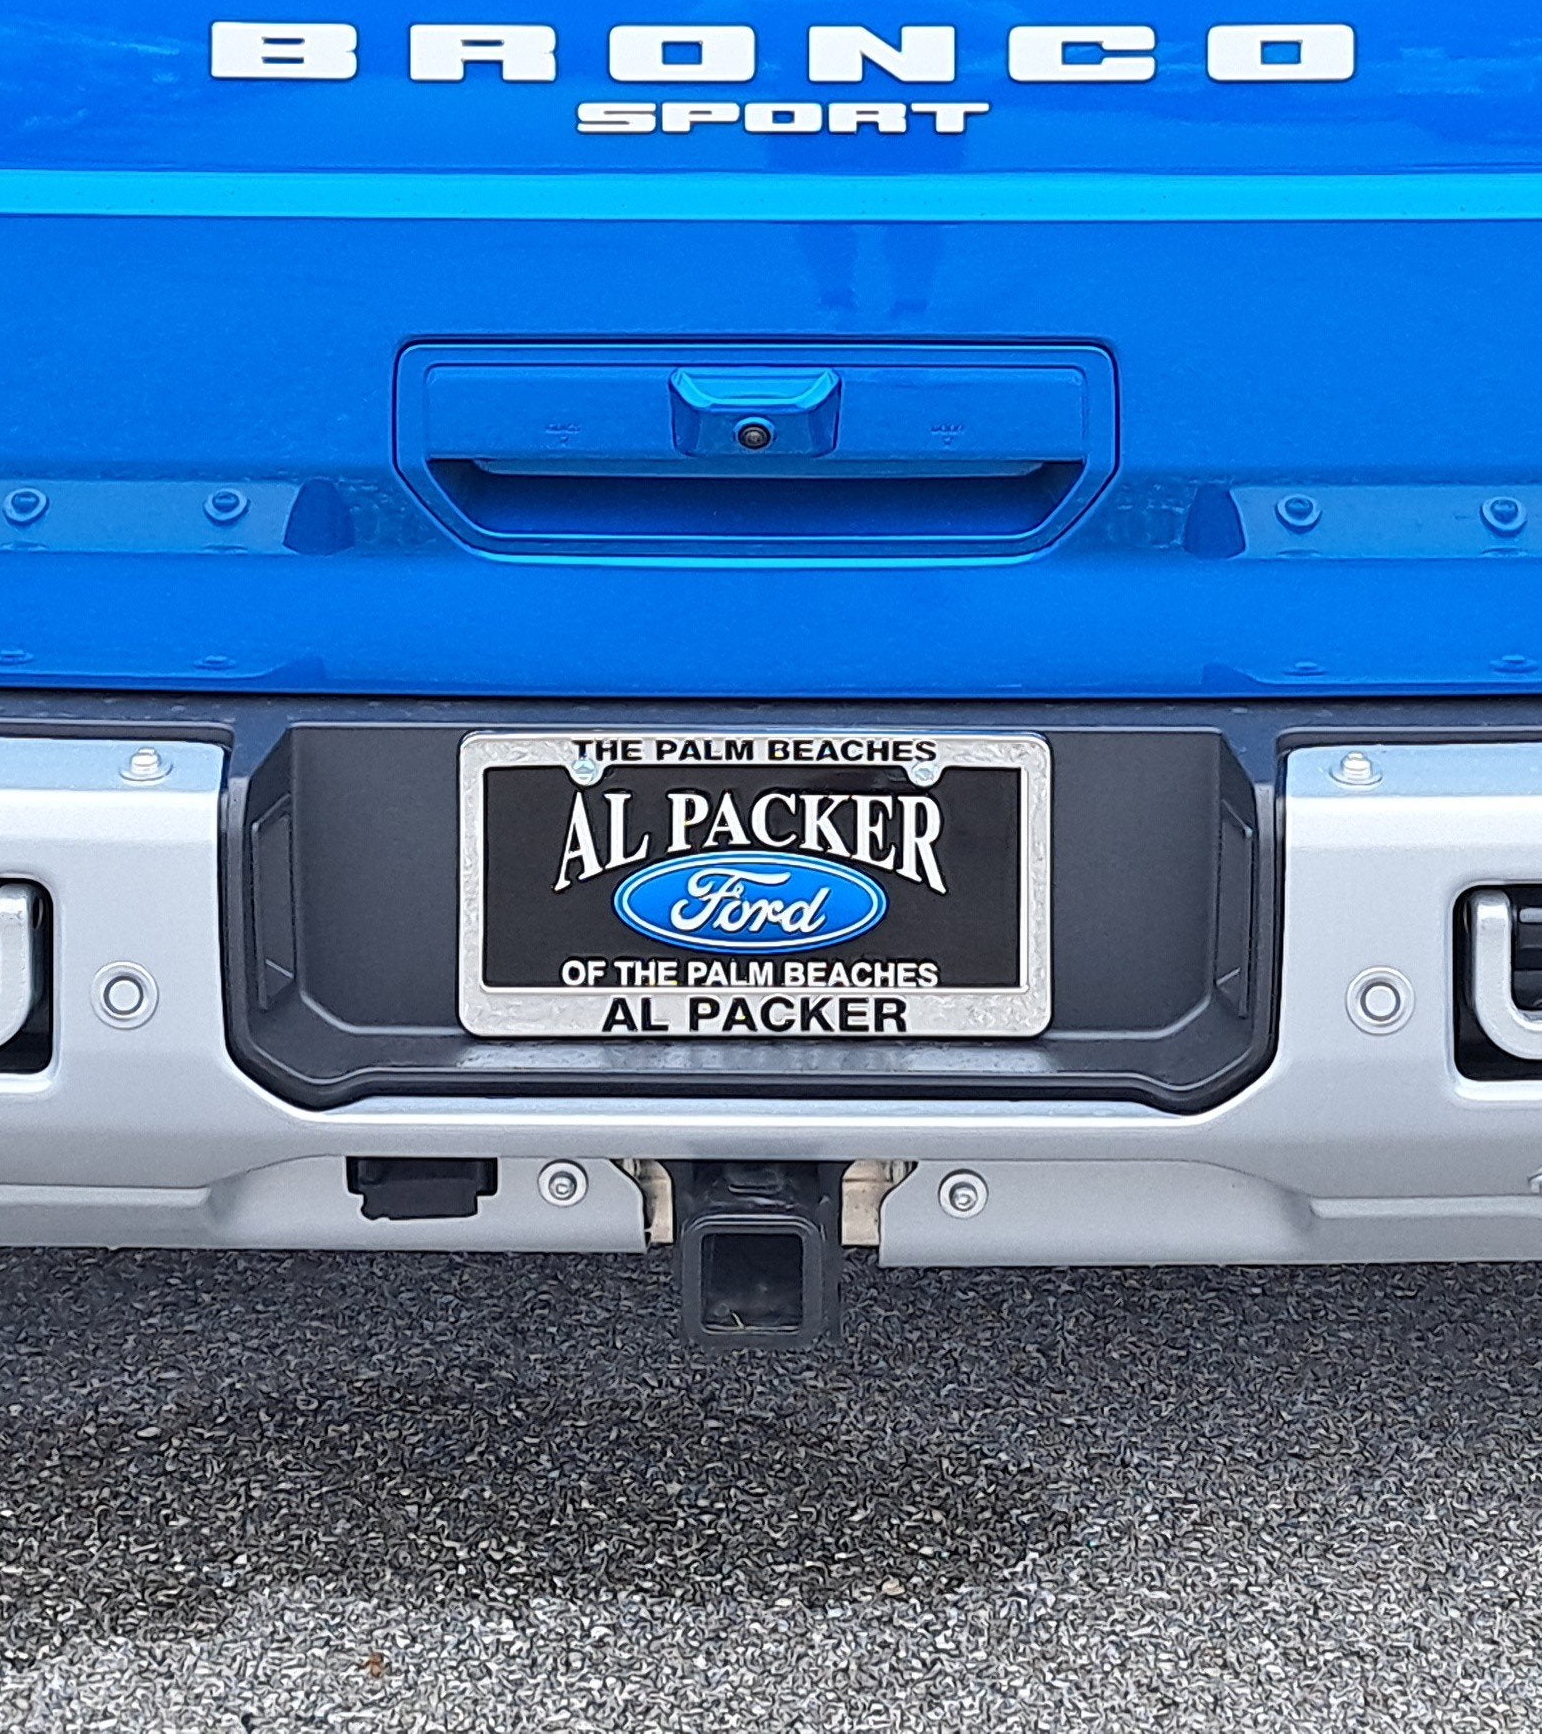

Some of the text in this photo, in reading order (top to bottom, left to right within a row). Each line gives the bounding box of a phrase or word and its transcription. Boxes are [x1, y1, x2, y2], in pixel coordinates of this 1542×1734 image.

[210, 21, 1356, 83] BRONCO
[577, 102, 990, 134] SPORT
[572, 739, 937, 762] THE PALM BEACHES
[554, 790, 948, 896] AL PACKER
[670, 867, 833, 933] Ford
[561, 959, 939, 988] OF THE PALM BEACHES
[601, 995, 907, 1033] AL PACKER
